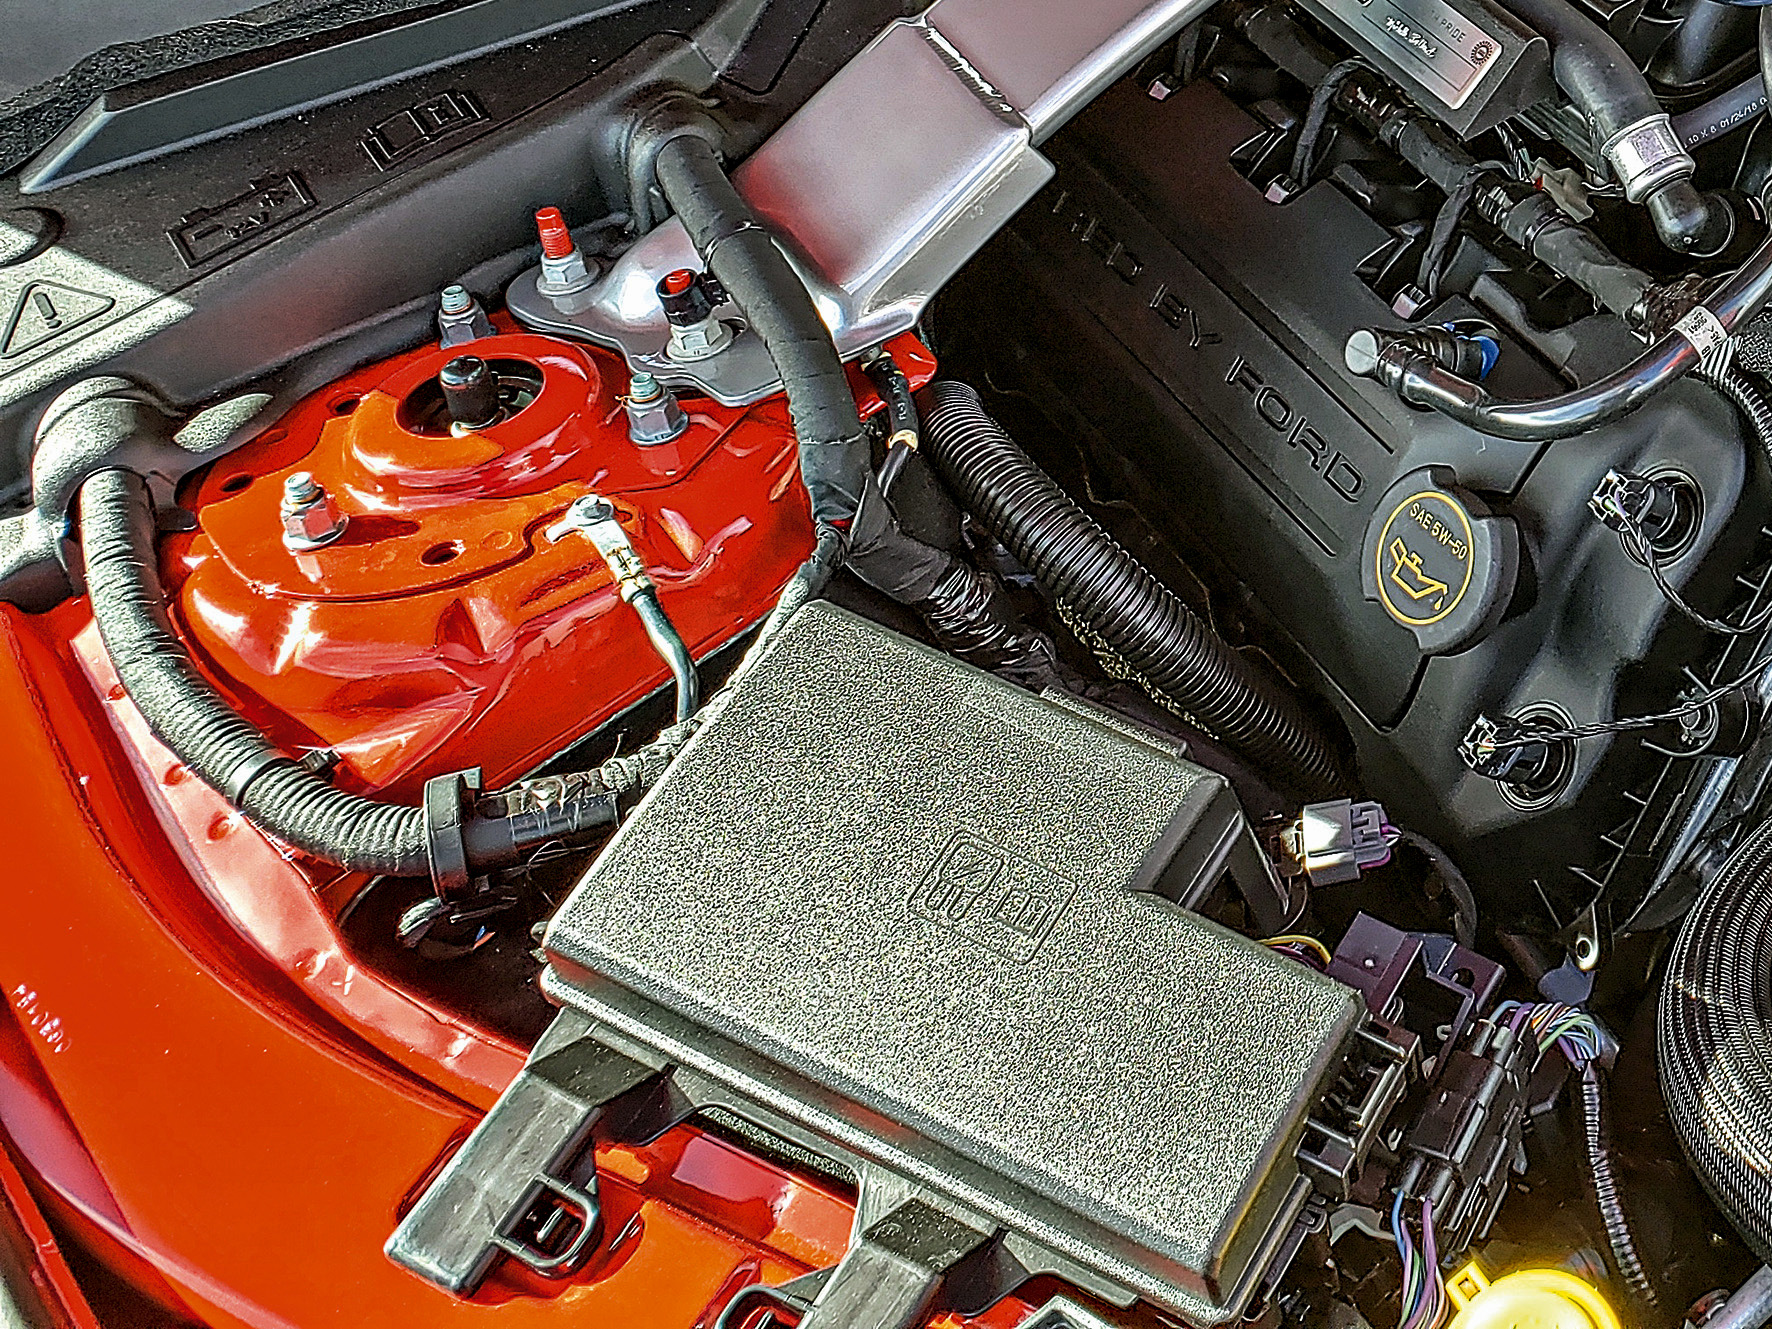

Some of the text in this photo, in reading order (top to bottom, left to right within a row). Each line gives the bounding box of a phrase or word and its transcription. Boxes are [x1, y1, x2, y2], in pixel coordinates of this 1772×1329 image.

[1225, 355, 1367, 503] FORD
[1408, 501, 1468, 560] SAE 5W-50
